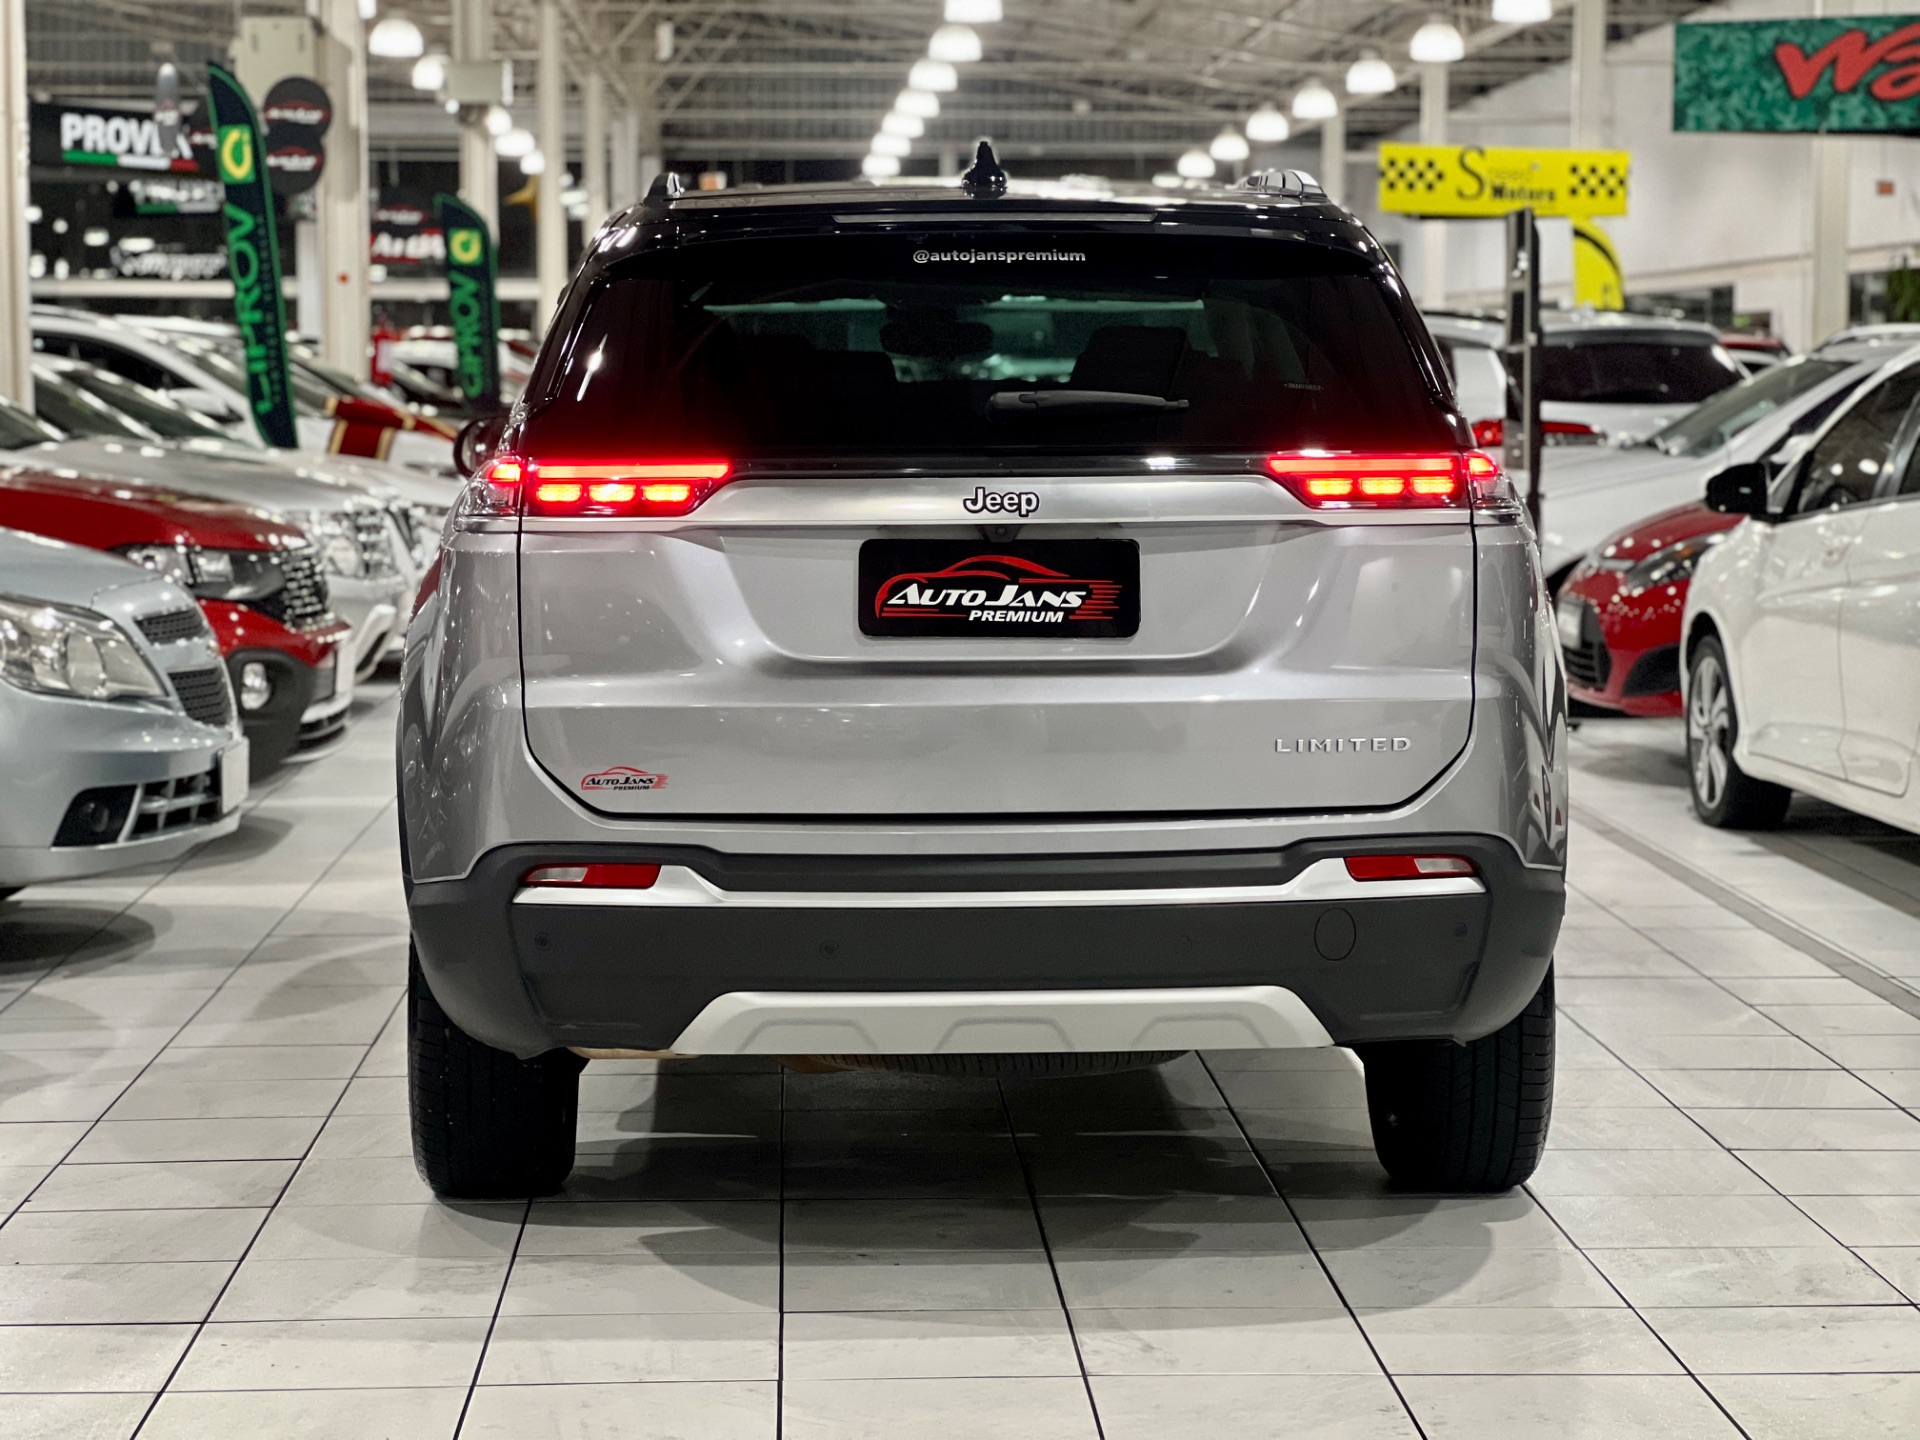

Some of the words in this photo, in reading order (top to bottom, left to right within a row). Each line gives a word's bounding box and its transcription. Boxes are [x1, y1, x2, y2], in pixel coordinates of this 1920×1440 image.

[912, 248, 1086, 263] @autojanspremium
[963, 487, 1040, 517] Jeep
[968, 609, 1064, 623] PREMIUM
[1275, 737, 1412, 752] LIMITED
